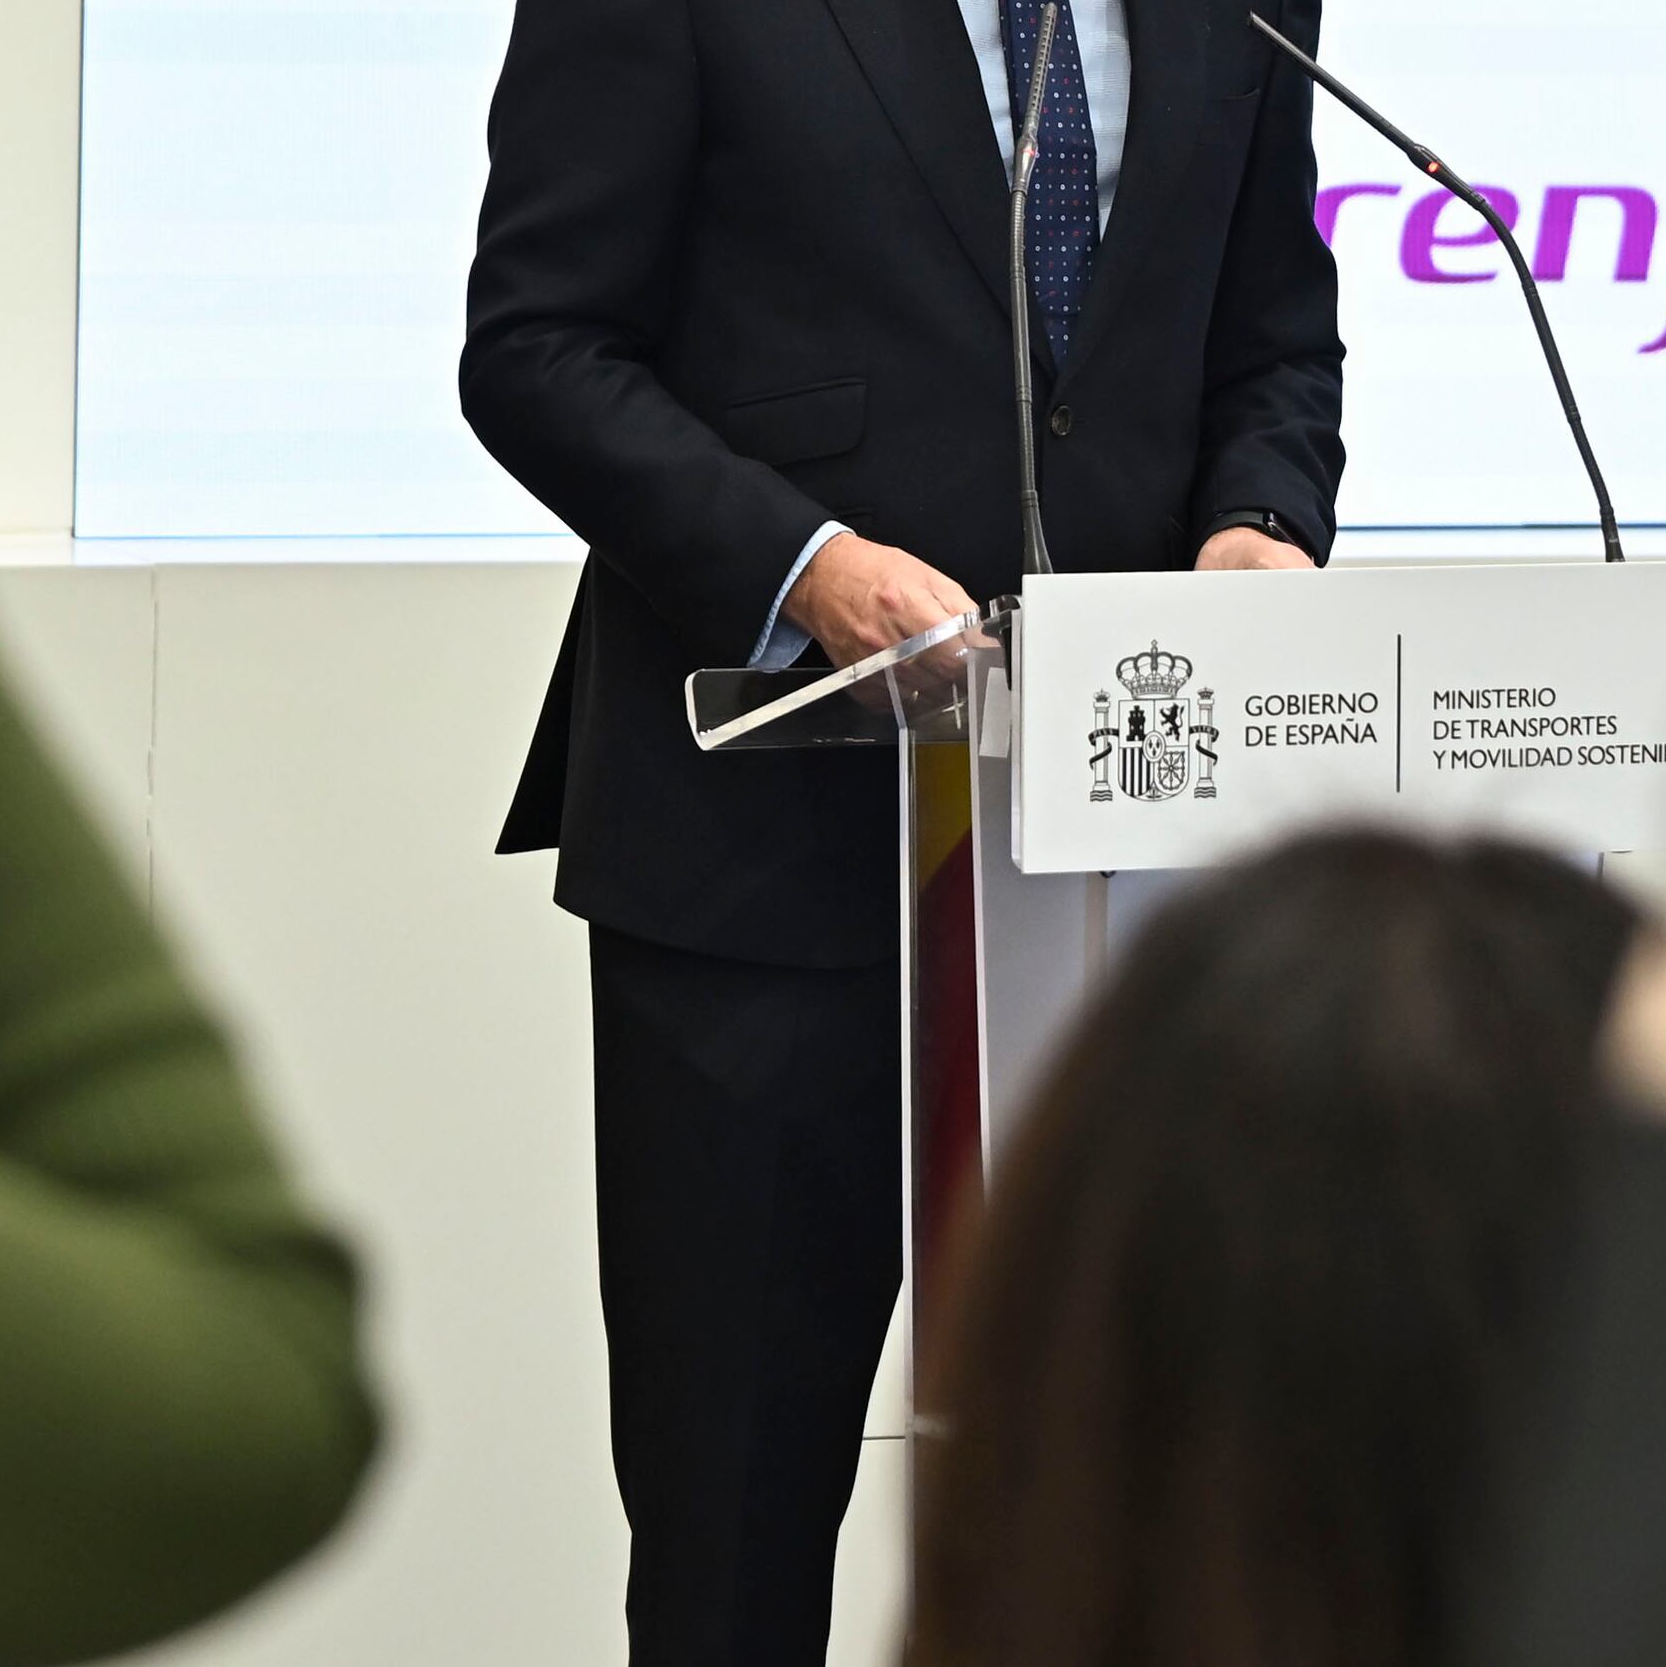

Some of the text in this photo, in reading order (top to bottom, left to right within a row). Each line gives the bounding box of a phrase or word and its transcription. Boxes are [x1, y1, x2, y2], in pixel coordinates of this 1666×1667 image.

[1244, 692, 1379, 717] GOBIERNO
[1433, 687, 1557, 710] MINISTERIO
[1245, 717, 1378, 747] DE ESPAÑA
[1433, 715, 1618, 741] DE TRANSPORTES
[1432, 749, 1447, 770] Y
[1451, 746, 1573, 770] MOVILIDAD
